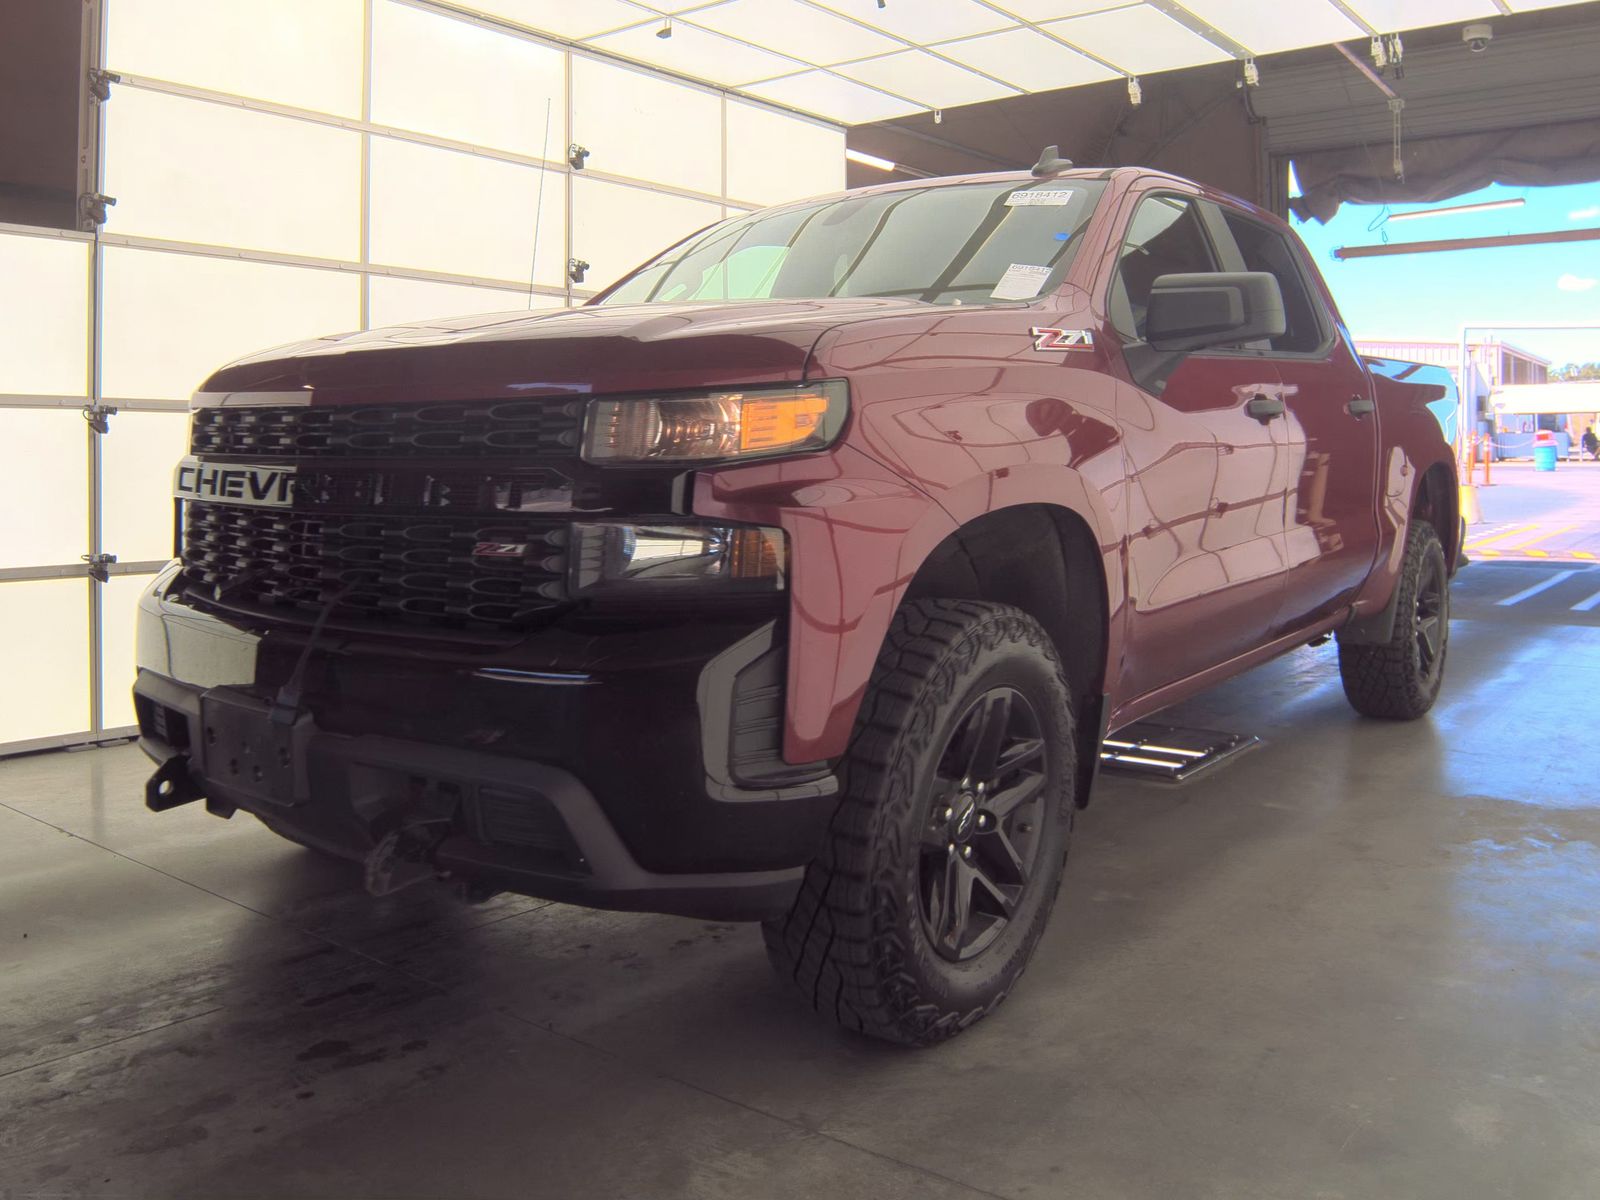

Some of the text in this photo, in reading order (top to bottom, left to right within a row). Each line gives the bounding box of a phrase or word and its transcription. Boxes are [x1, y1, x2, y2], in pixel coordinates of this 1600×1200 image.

[1011, 191, 1068, 200] 6918412
[1031, 327, 1094, 352] Z71
[472, 541, 528, 557] Z71
